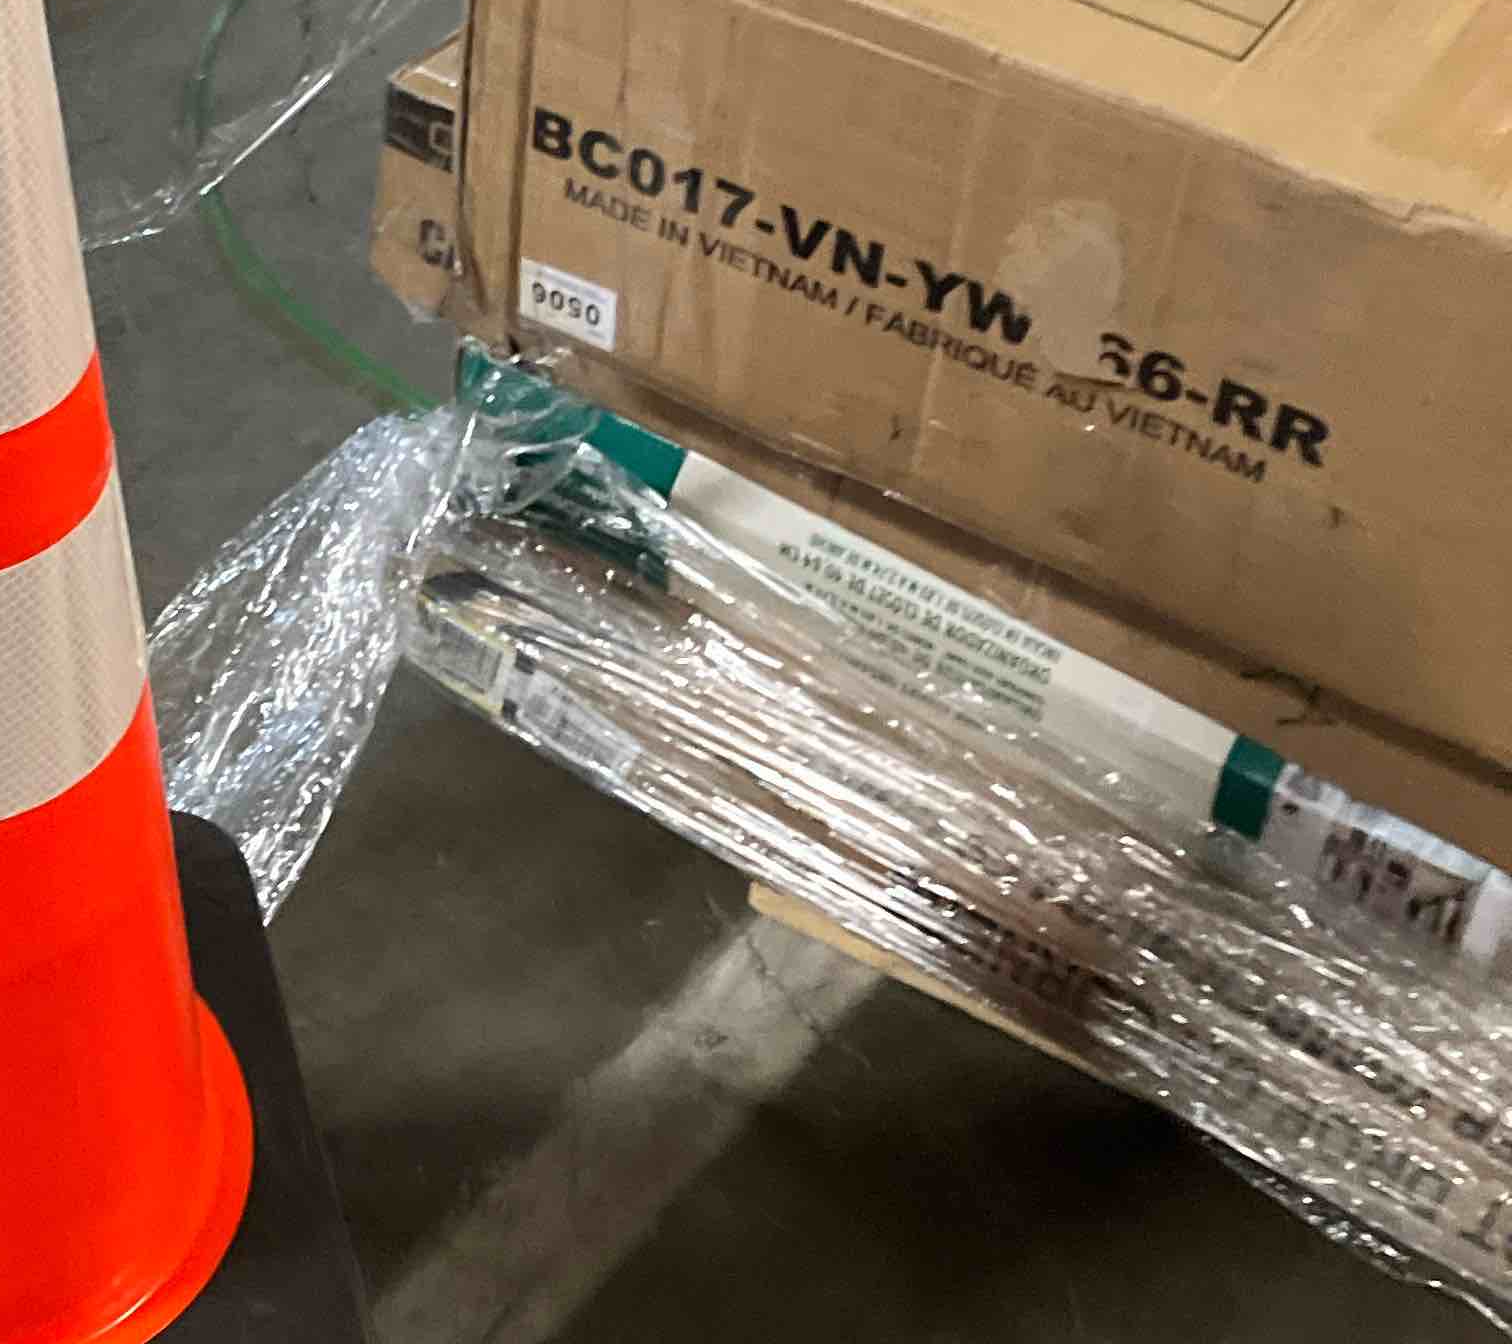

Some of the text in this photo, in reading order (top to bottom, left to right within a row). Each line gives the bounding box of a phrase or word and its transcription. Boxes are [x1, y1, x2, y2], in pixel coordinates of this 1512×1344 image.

[564, 177, 651, 231] MADE
[658, 217, 690, 249] IN
[698, 231, 839, 311] VIETNAM
[844, 295, 860, 318] /
[1044, 382, 1097, 415] AU
[1104, 396, 1269, 485] VIETNAM
